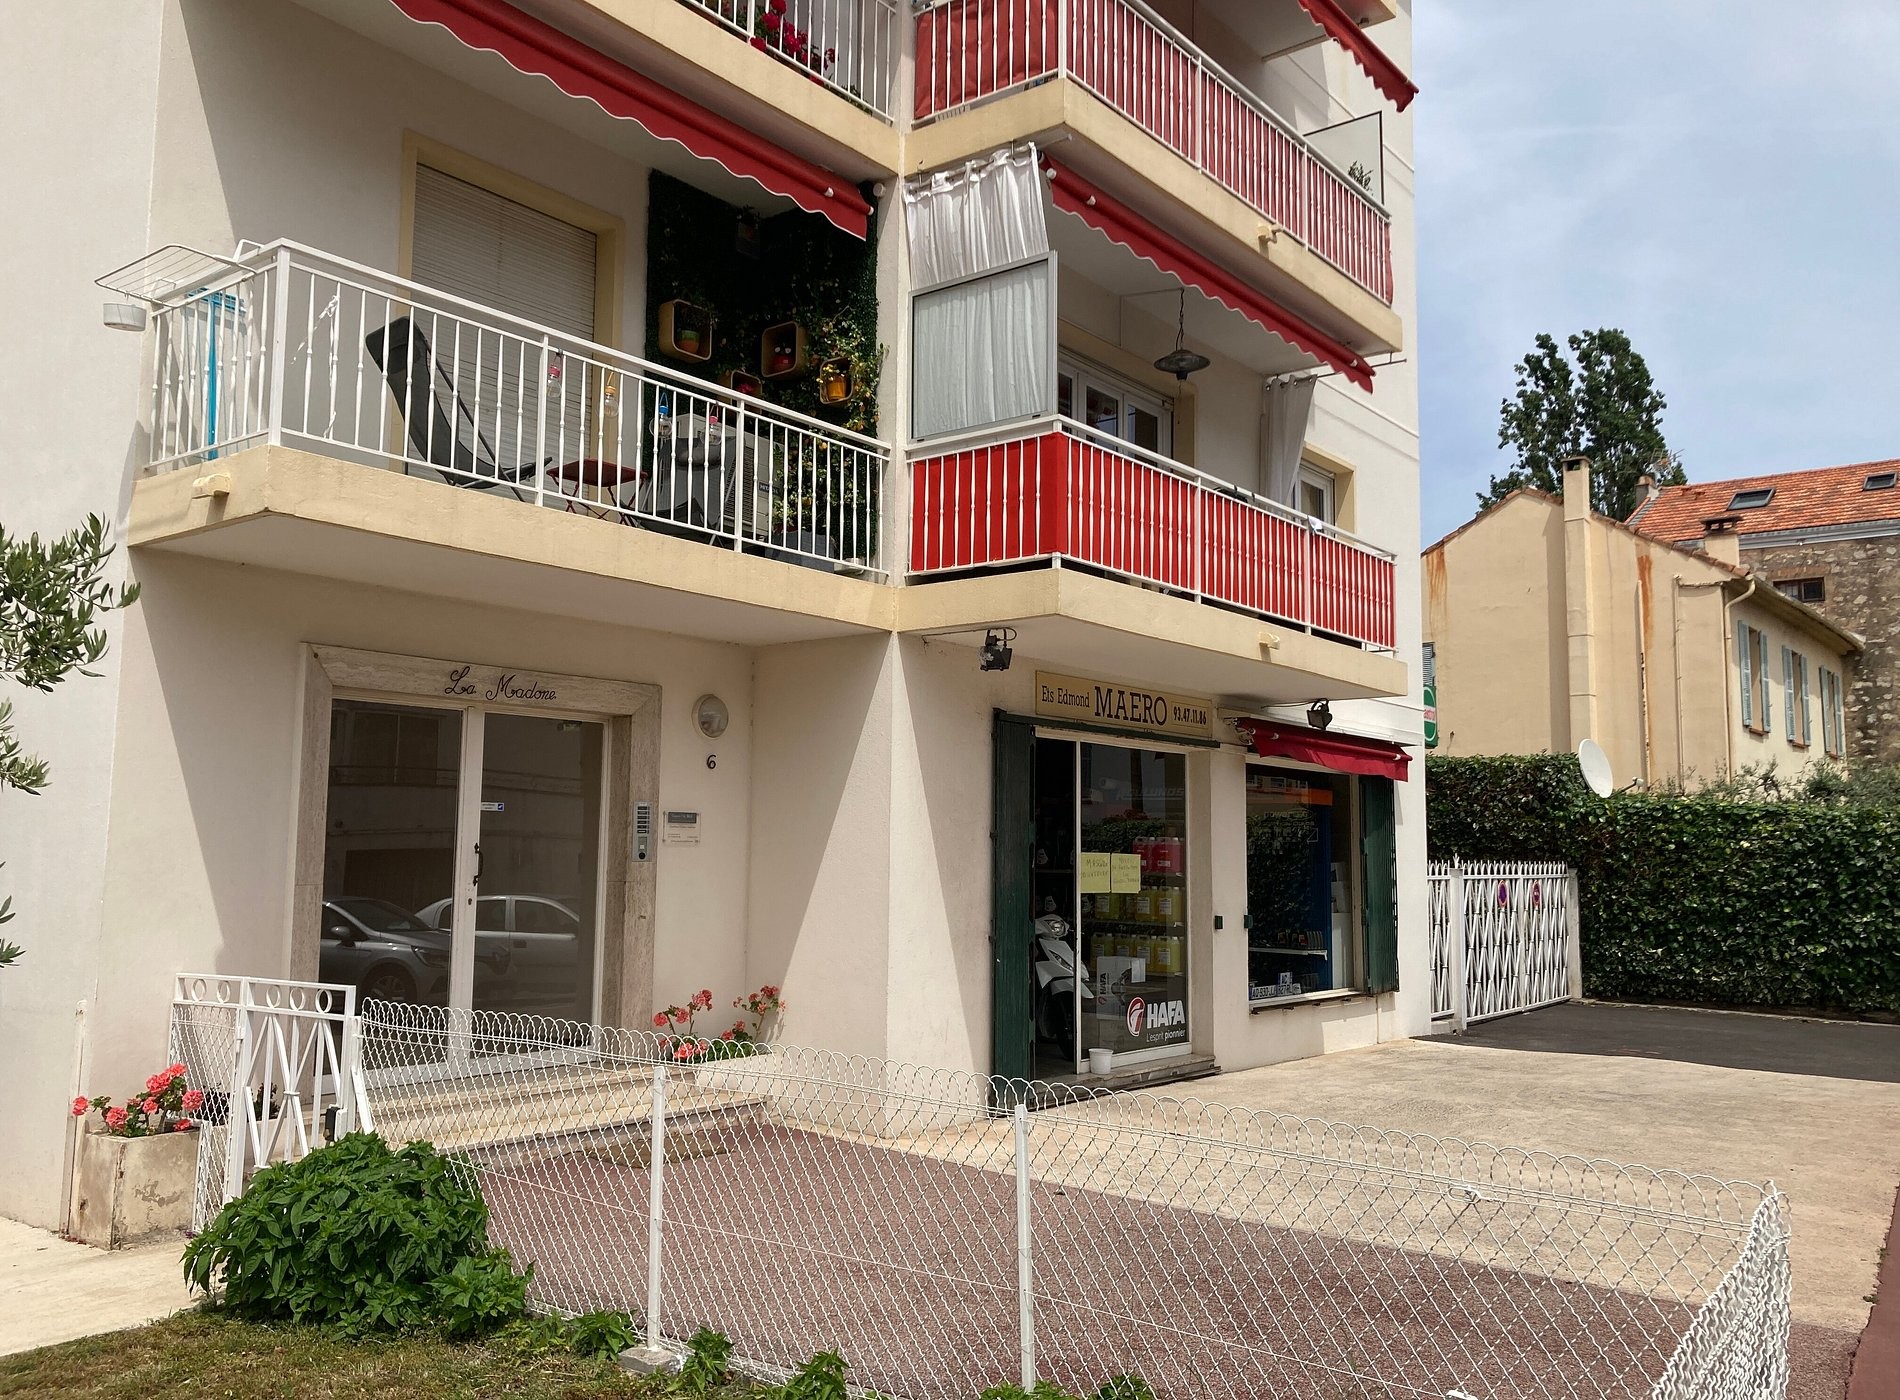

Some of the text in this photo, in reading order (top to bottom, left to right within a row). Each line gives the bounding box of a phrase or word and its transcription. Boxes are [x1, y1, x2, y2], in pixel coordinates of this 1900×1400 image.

[444, 666, 557, 701] La Madone
[1041, 685, 1055, 703] Ets
[1057, 687, 1090, 708] Edmond
[1094, 685, 1168, 726] MAERO
[706, 754, 717, 770] 6
[1146, 1000, 1186, 1029] HAFA
[1146, 1029, 1186, 1043] L'esprit pionnier
